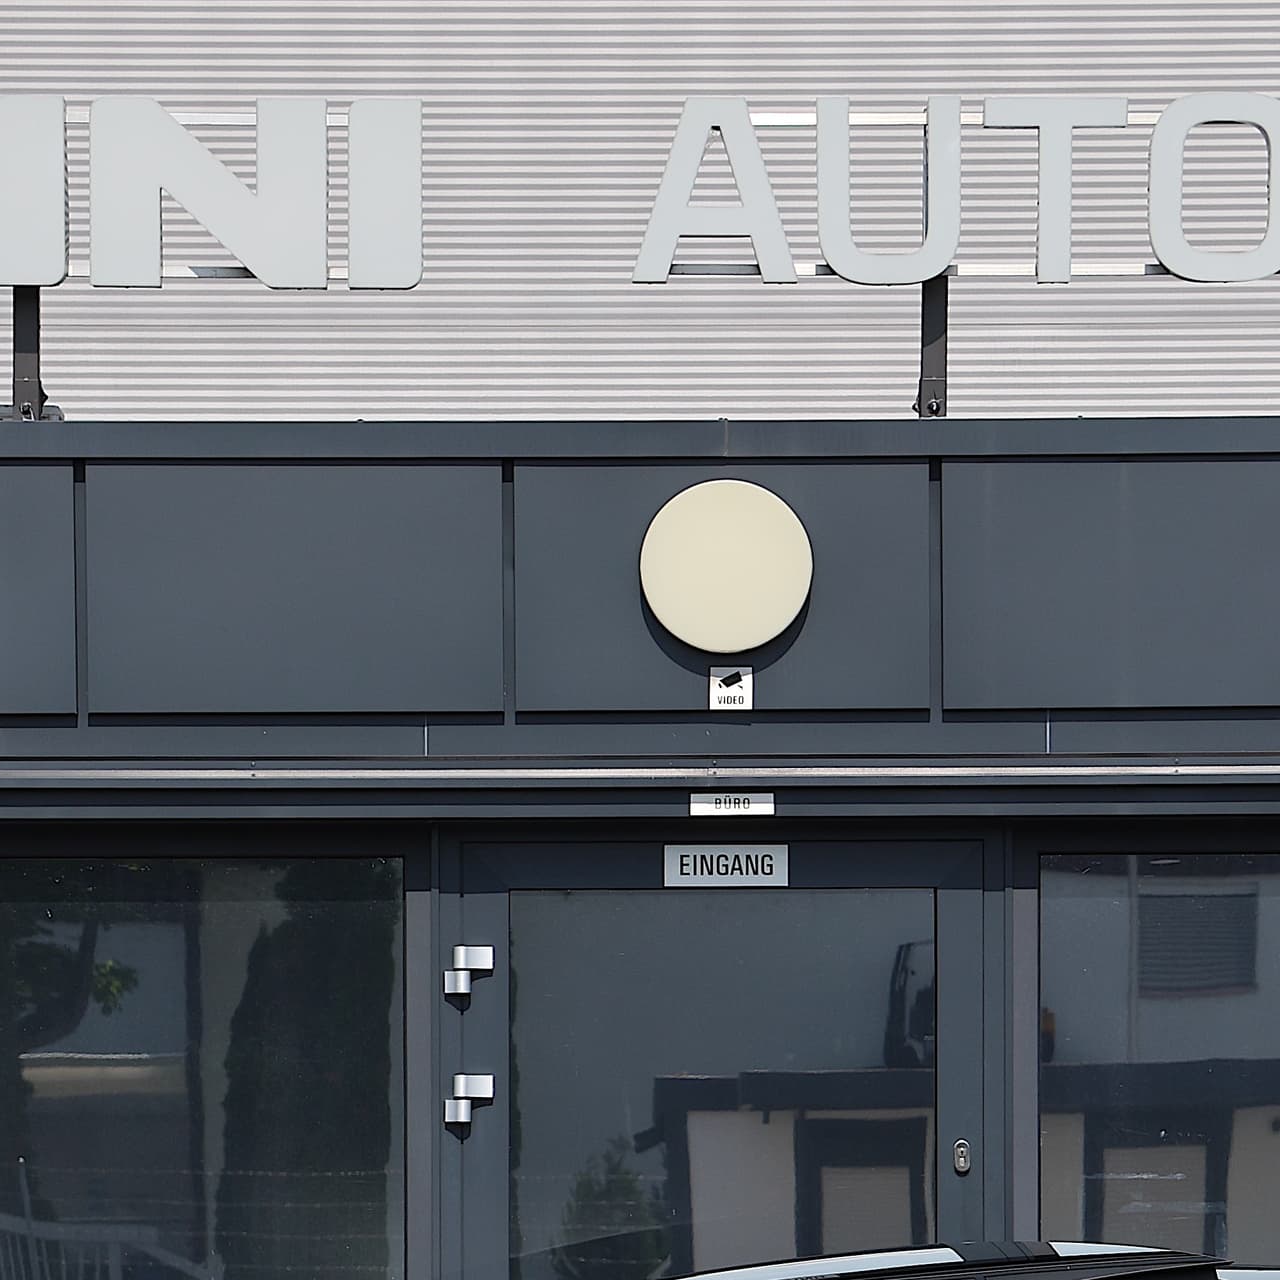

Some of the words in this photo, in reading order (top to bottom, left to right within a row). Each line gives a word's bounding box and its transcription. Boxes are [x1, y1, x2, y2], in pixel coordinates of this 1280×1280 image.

[717, 695, 745, 705] VIDEO
[714, 795, 751, 809] BÜRO
[679, 854, 774, 876] EINGANG
